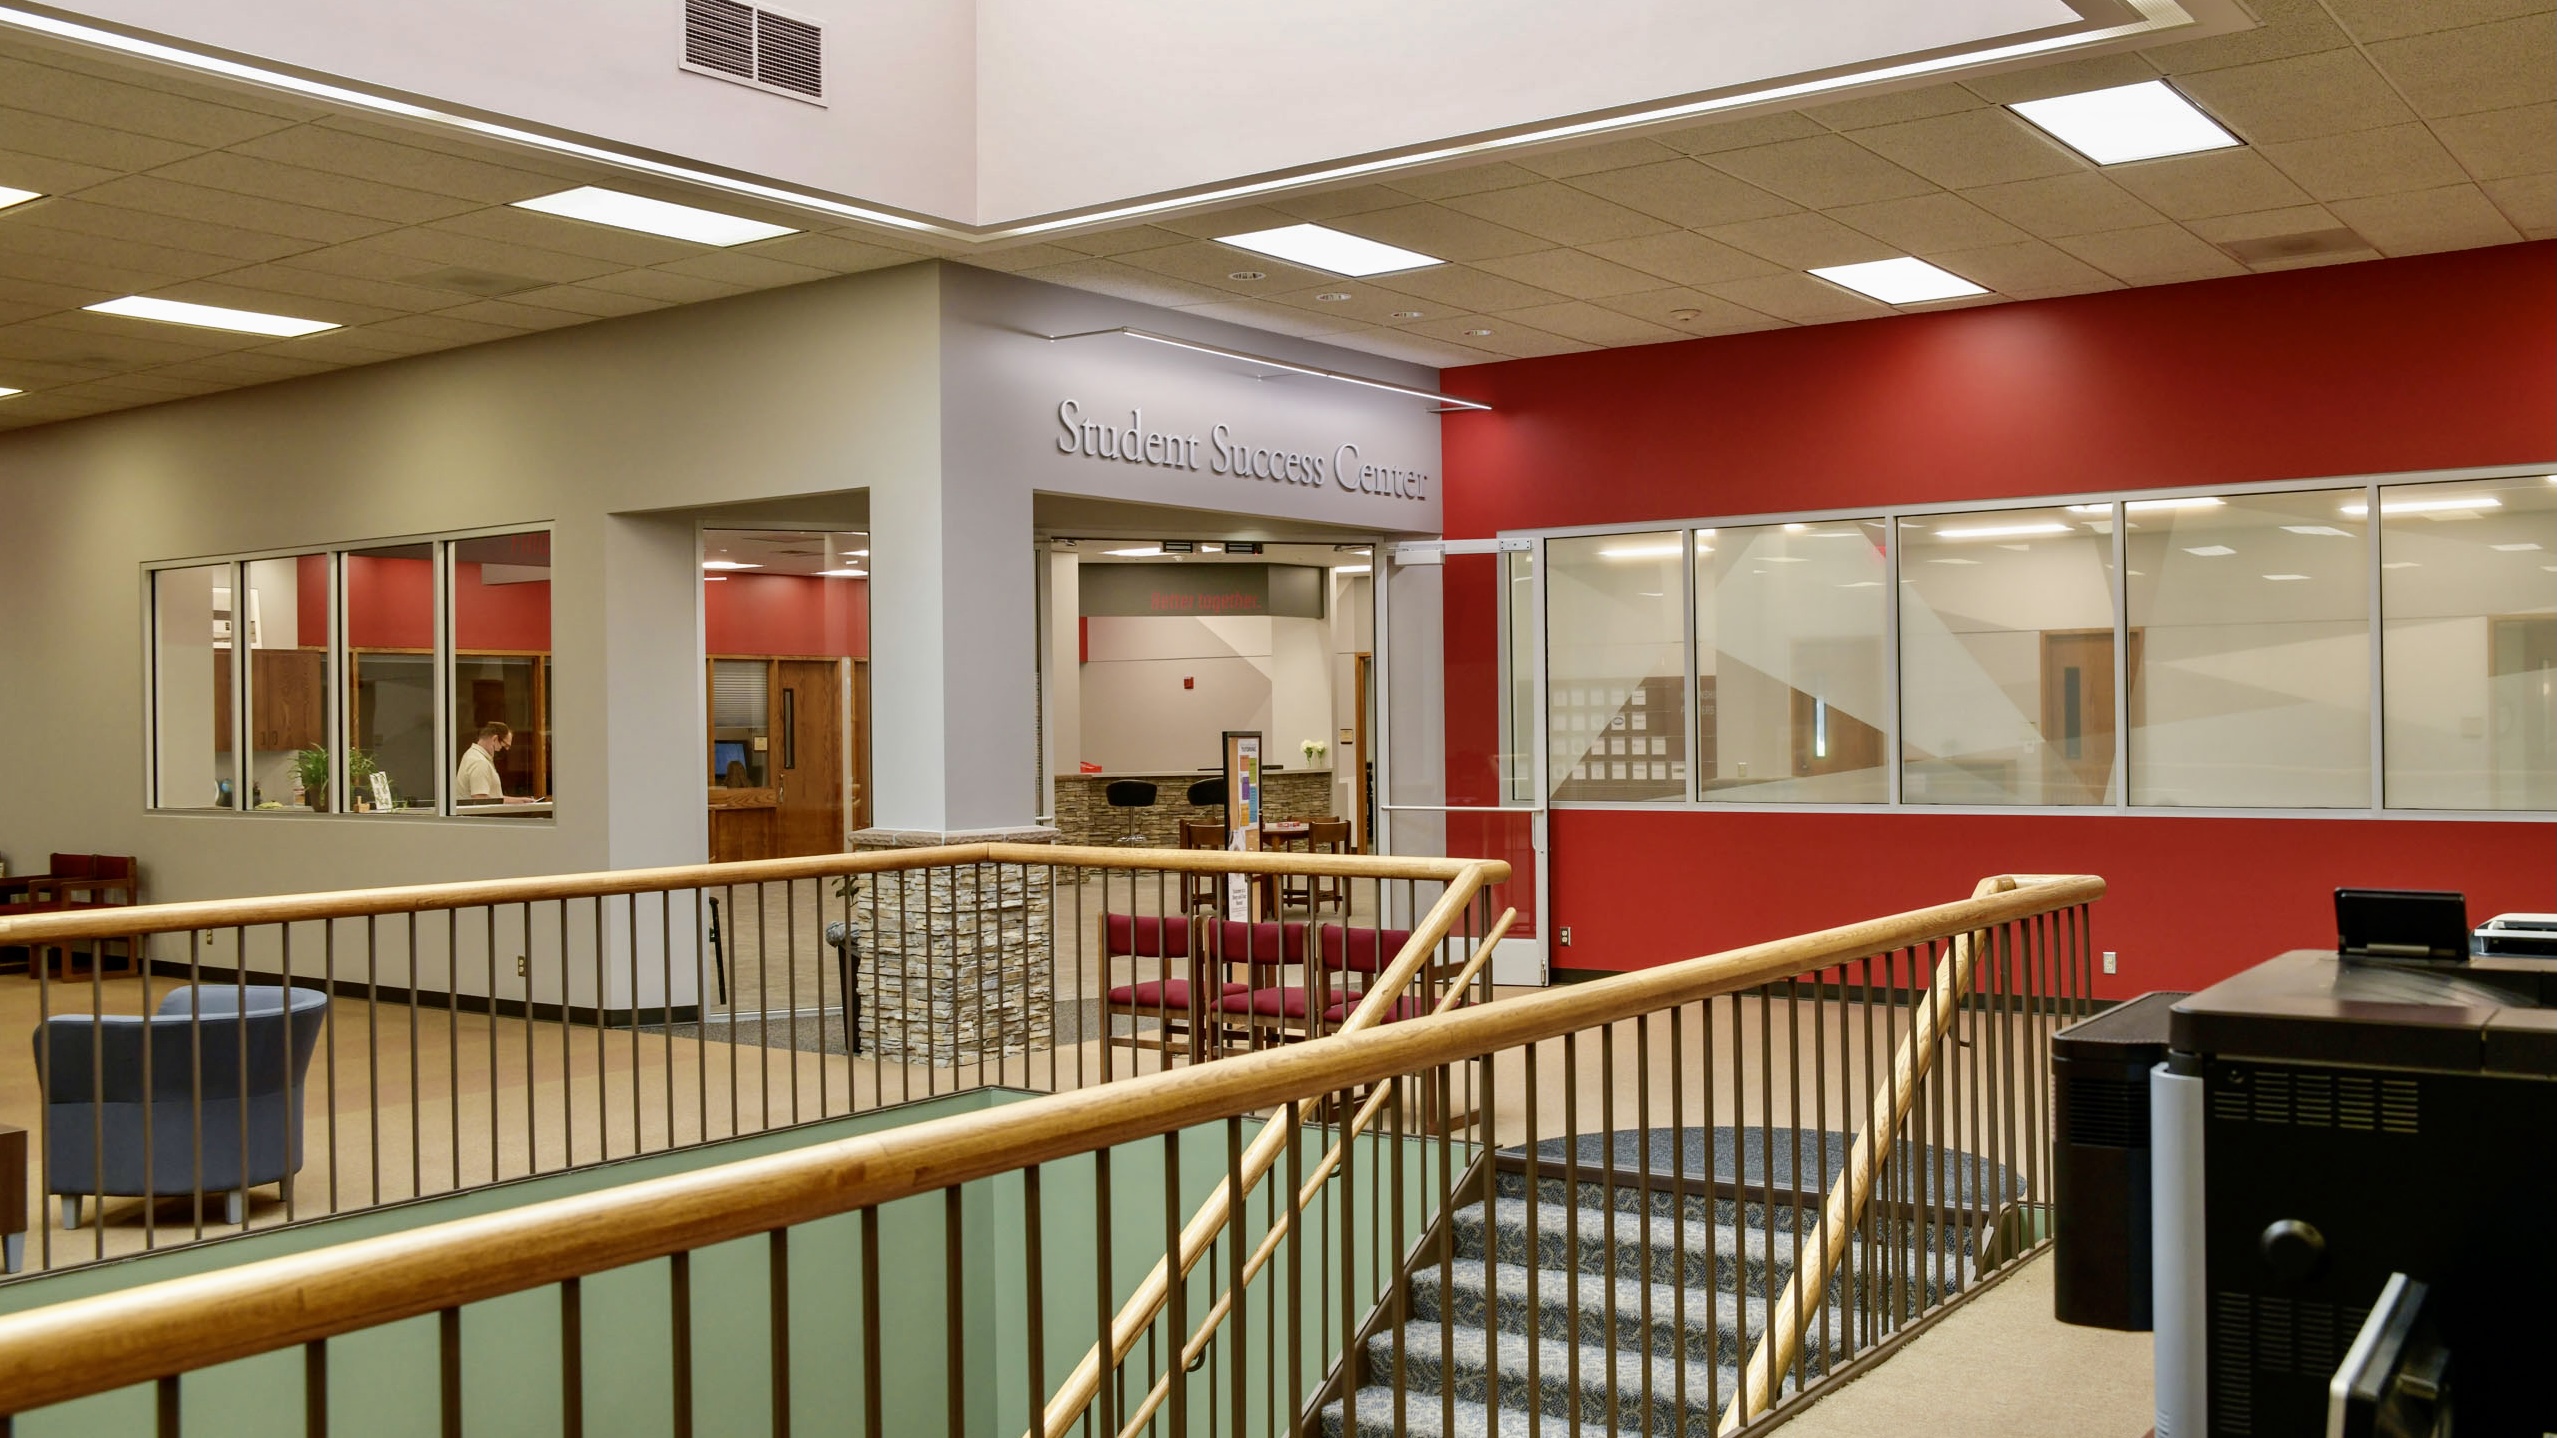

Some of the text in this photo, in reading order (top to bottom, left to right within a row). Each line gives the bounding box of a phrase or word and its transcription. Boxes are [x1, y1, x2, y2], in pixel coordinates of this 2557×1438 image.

[1056, 398, 1430, 501] Student Success Center
